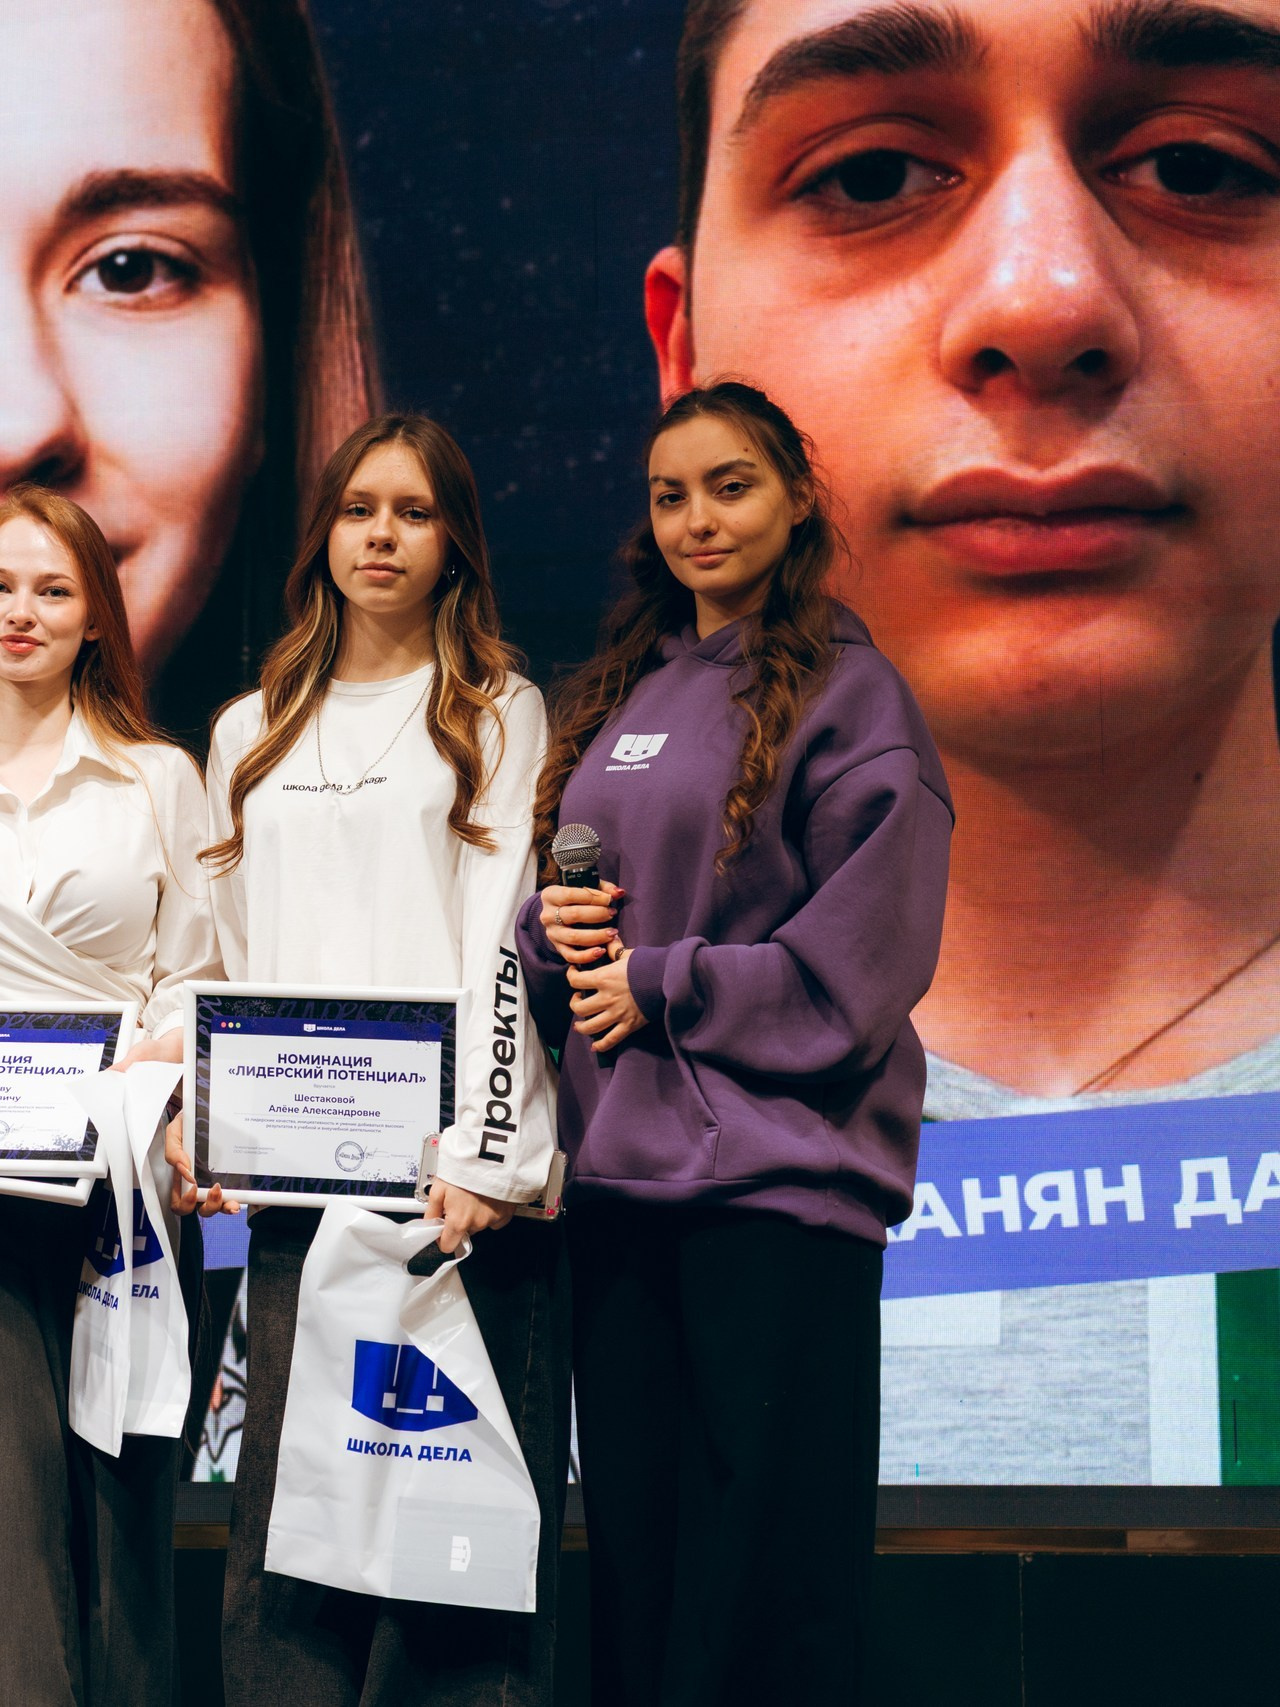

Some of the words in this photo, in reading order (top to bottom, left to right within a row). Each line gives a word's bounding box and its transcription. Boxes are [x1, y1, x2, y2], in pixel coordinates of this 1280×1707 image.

[631, 763, 650, 771] ДЕЛА
[282, 784, 318, 792] школа
[278, 1053, 372, 1068] НОМИНАЦИЯ
[228, 1066, 323, 1080] «ЛИДЕРСКИЙ
[328, 1069, 426, 1084] ПОТЕНЦИАЛ»
[294, 1094, 356, 1104] Шестаковой
[268, 1104, 300, 1114] Алёне
[302, 1105, 381, 1118] Александровне
[131, 1284, 160, 1299] ЕЛА
[102, 1291, 119, 1310] ДЕЛА
[346, 1437, 414, 1458] ШКОЛА
[417, 1445, 473, 1463] ДЕЛА
